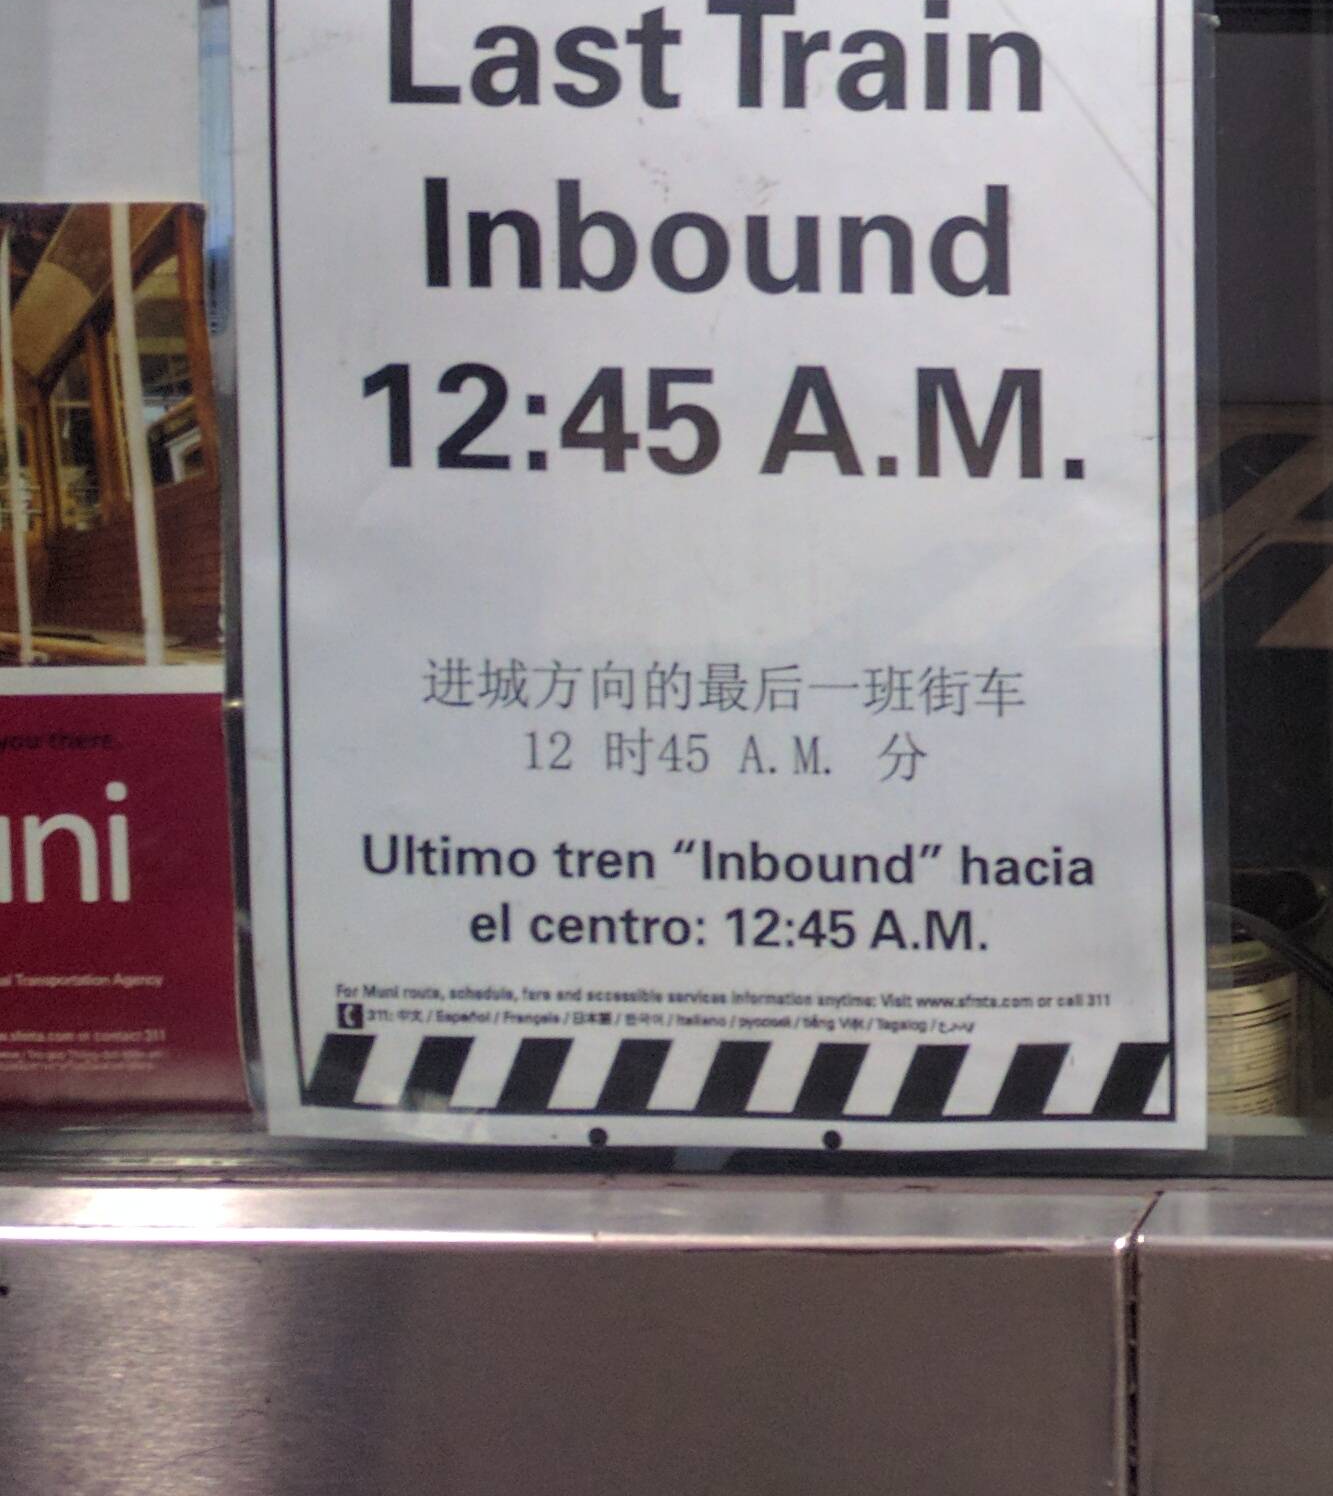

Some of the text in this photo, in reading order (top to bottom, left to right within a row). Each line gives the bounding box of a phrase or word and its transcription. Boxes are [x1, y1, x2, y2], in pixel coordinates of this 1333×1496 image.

[423, 176, 1012, 298] Inbound
[361, 362, 1087, 480] 12:45 A.M.
[421, 657, 1026, 717] 进城方向的最后一班街车
[524, 731, 574, 771] 12
[738, 735, 833, 775] A.M.
[879, 732, 928, 781] 分
[362, 833, 1096, 888] Ultimo tren “Inbound” hacia
[470, 903, 991, 952] el centro: 12:45 A.M.
[15, 972, 111, 990] Transportation
[113, 972, 165, 990] Agency
[336, 985, 1111, 1009] For Muni route, schedule, fare and accessible services information anytime: Visit www.sfmta.com or call 311
[435, 1009, 490, 1025] Español
[877, 1018, 927, 1034] Tagalog
